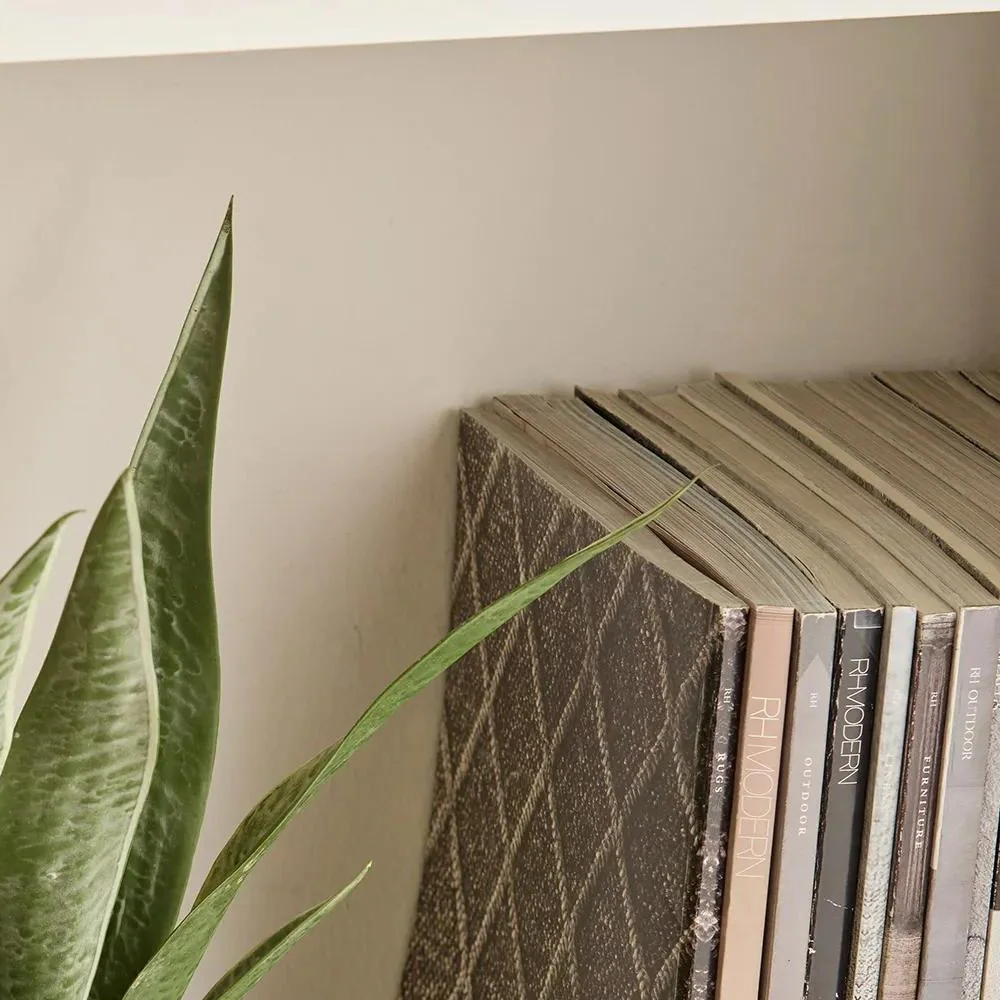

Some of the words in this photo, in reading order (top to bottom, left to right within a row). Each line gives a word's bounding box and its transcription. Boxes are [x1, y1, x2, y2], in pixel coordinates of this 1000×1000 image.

[969, 667, 981, 684] RH
[723, 688, 734, 704] RH
[809, 692, 818, 708] RH
[962, 689, 979, 761] OUTDOOR
[714, 753, 727, 793] RUGS
[798, 757, 813, 836] OUTDOOR
[915, 756, 932, 851] FURNITURE
